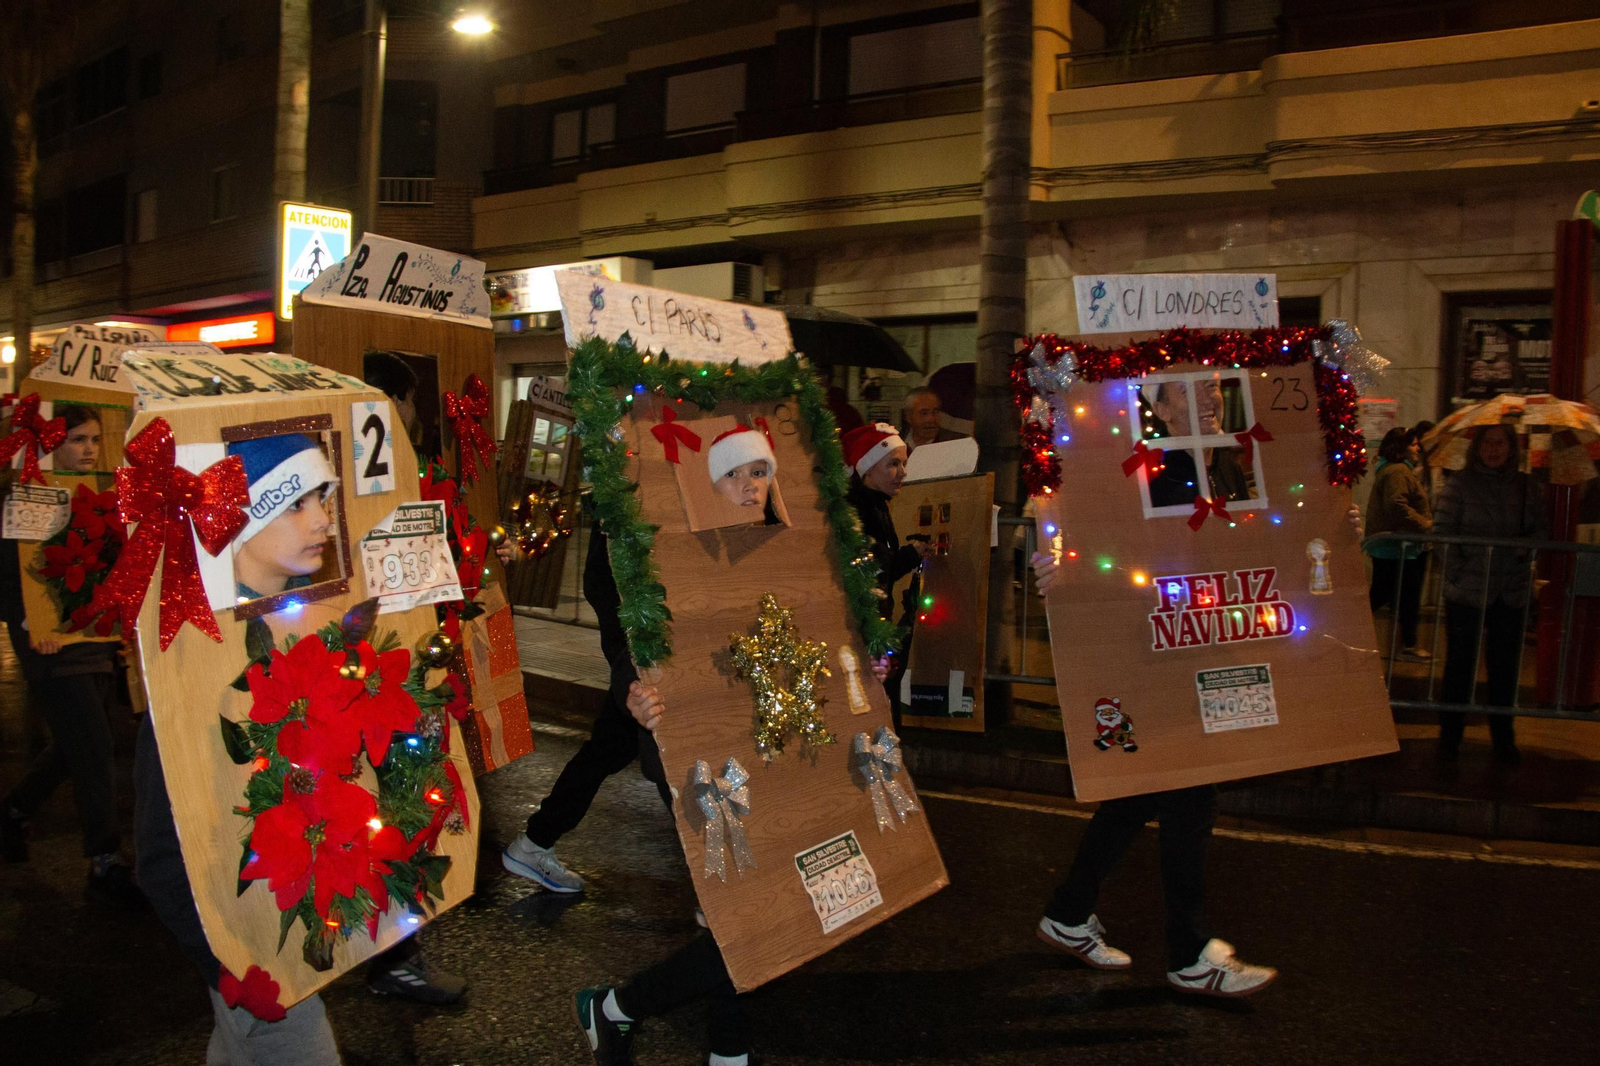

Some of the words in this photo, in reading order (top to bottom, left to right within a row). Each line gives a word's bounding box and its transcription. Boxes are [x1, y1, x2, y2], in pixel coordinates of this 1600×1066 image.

[289, 211, 348, 229] ATENCION
[632, 296, 654, 335] C/
[664, 298, 721, 343] PARIS
[1123, 285, 1144, 320] C/
[1155, 289, 1244, 316] LONDRES
[59, 341, 88, 377] C/
[90, 345, 119, 383] RUIZ
[1271, 377, 1310, 411] 23
[361, 414, 388, 478] 2
[251, 474, 301, 519] wiber
[395, 508, 434, 519] SILVESTRE
[403, 524, 412, 532] DE
[382, 550, 437, 589] 933
[1154, 567, 1280, 614] FELIZ
[1149, 600, 1296, 651] NAVIDAD
[1203, 672, 1220, 680] SAN
[1210, 692, 1268, 718] 1045
[803, 853, 817, 866] SAN
[816, 839, 848, 860] SILVESTRE
[808, 860, 827, 873] CIUDAD
[826, 857, 834, 865] DE
[820, 868, 871, 911] 1046
